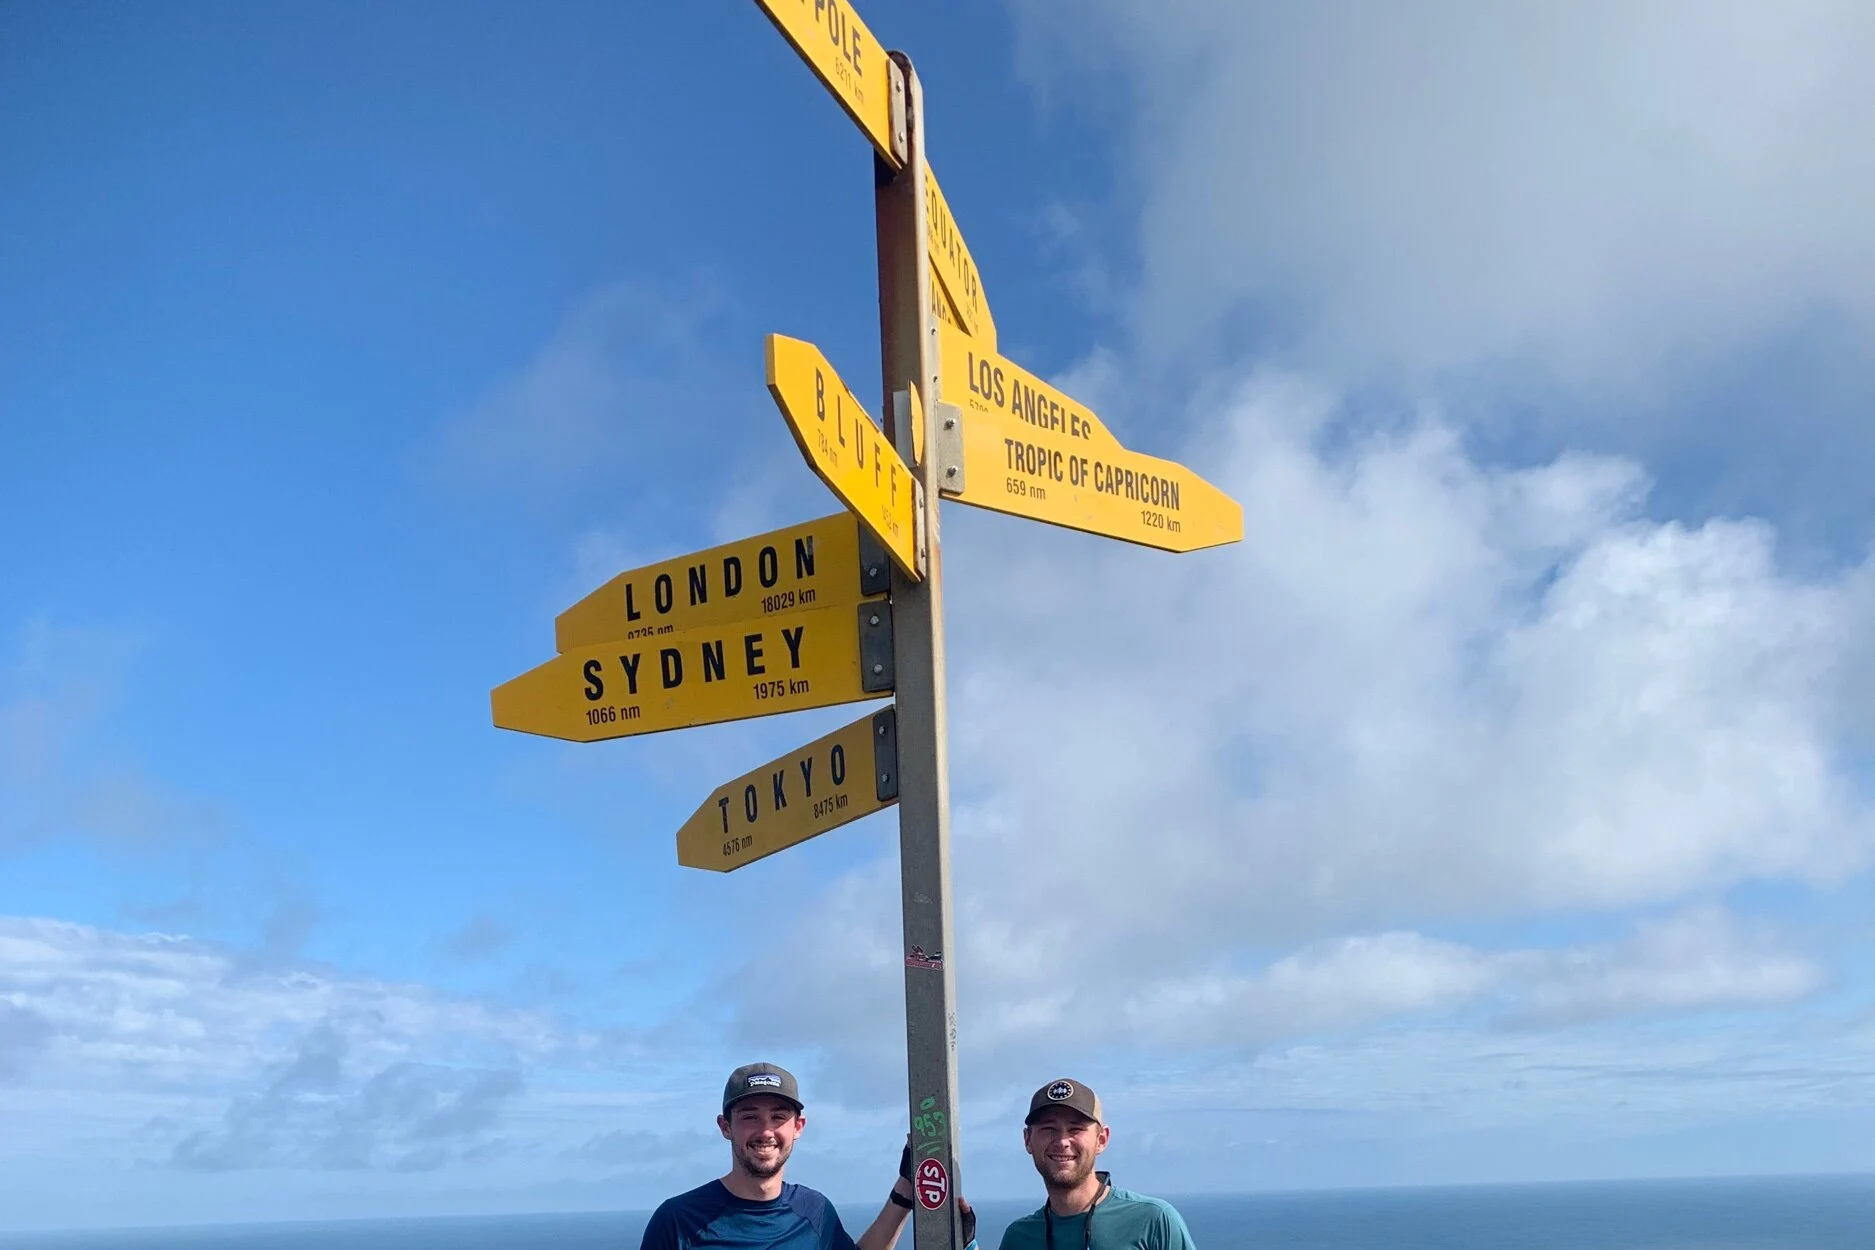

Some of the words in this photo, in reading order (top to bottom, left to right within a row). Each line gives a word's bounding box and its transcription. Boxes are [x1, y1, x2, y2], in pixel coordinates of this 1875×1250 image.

[925, 174, 978, 314] QUATOR
[968, 351, 1005, 408] LOS
[815, 367, 897, 509] BLUFF
[1004, 438, 1064, 483] TROPIC
[1069, 453, 1089, 487] OF
[1094, 461, 1180, 511] CAPRICORN
[1006, 478, 1027, 496] 659
[1030, 485, 1046, 501] nm
[1141, 510, 1164, 530] 1220
[1167, 516, 1181, 534] km
[626, 535, 816, 622] LONDON
[761, 591, 795, 614] 18029
[798, 588, 816, 605] km
[583, 626, 805, 702] SYDNEY
[753, 681, 786, 700] 1975
[789, 678, 810, 695] km
[586, 707, 617, 726] 1066
[621, 703, 641, 720] nm
[718, 744, 846, 834] TOKYO
[813, 797, 834, 819] 8475
[835, 793, 848, 809] km
[722, 837, 740, 857] 4576
[741, 834, 753, 850] nm
[921, 1165, 946, 1204] STP
